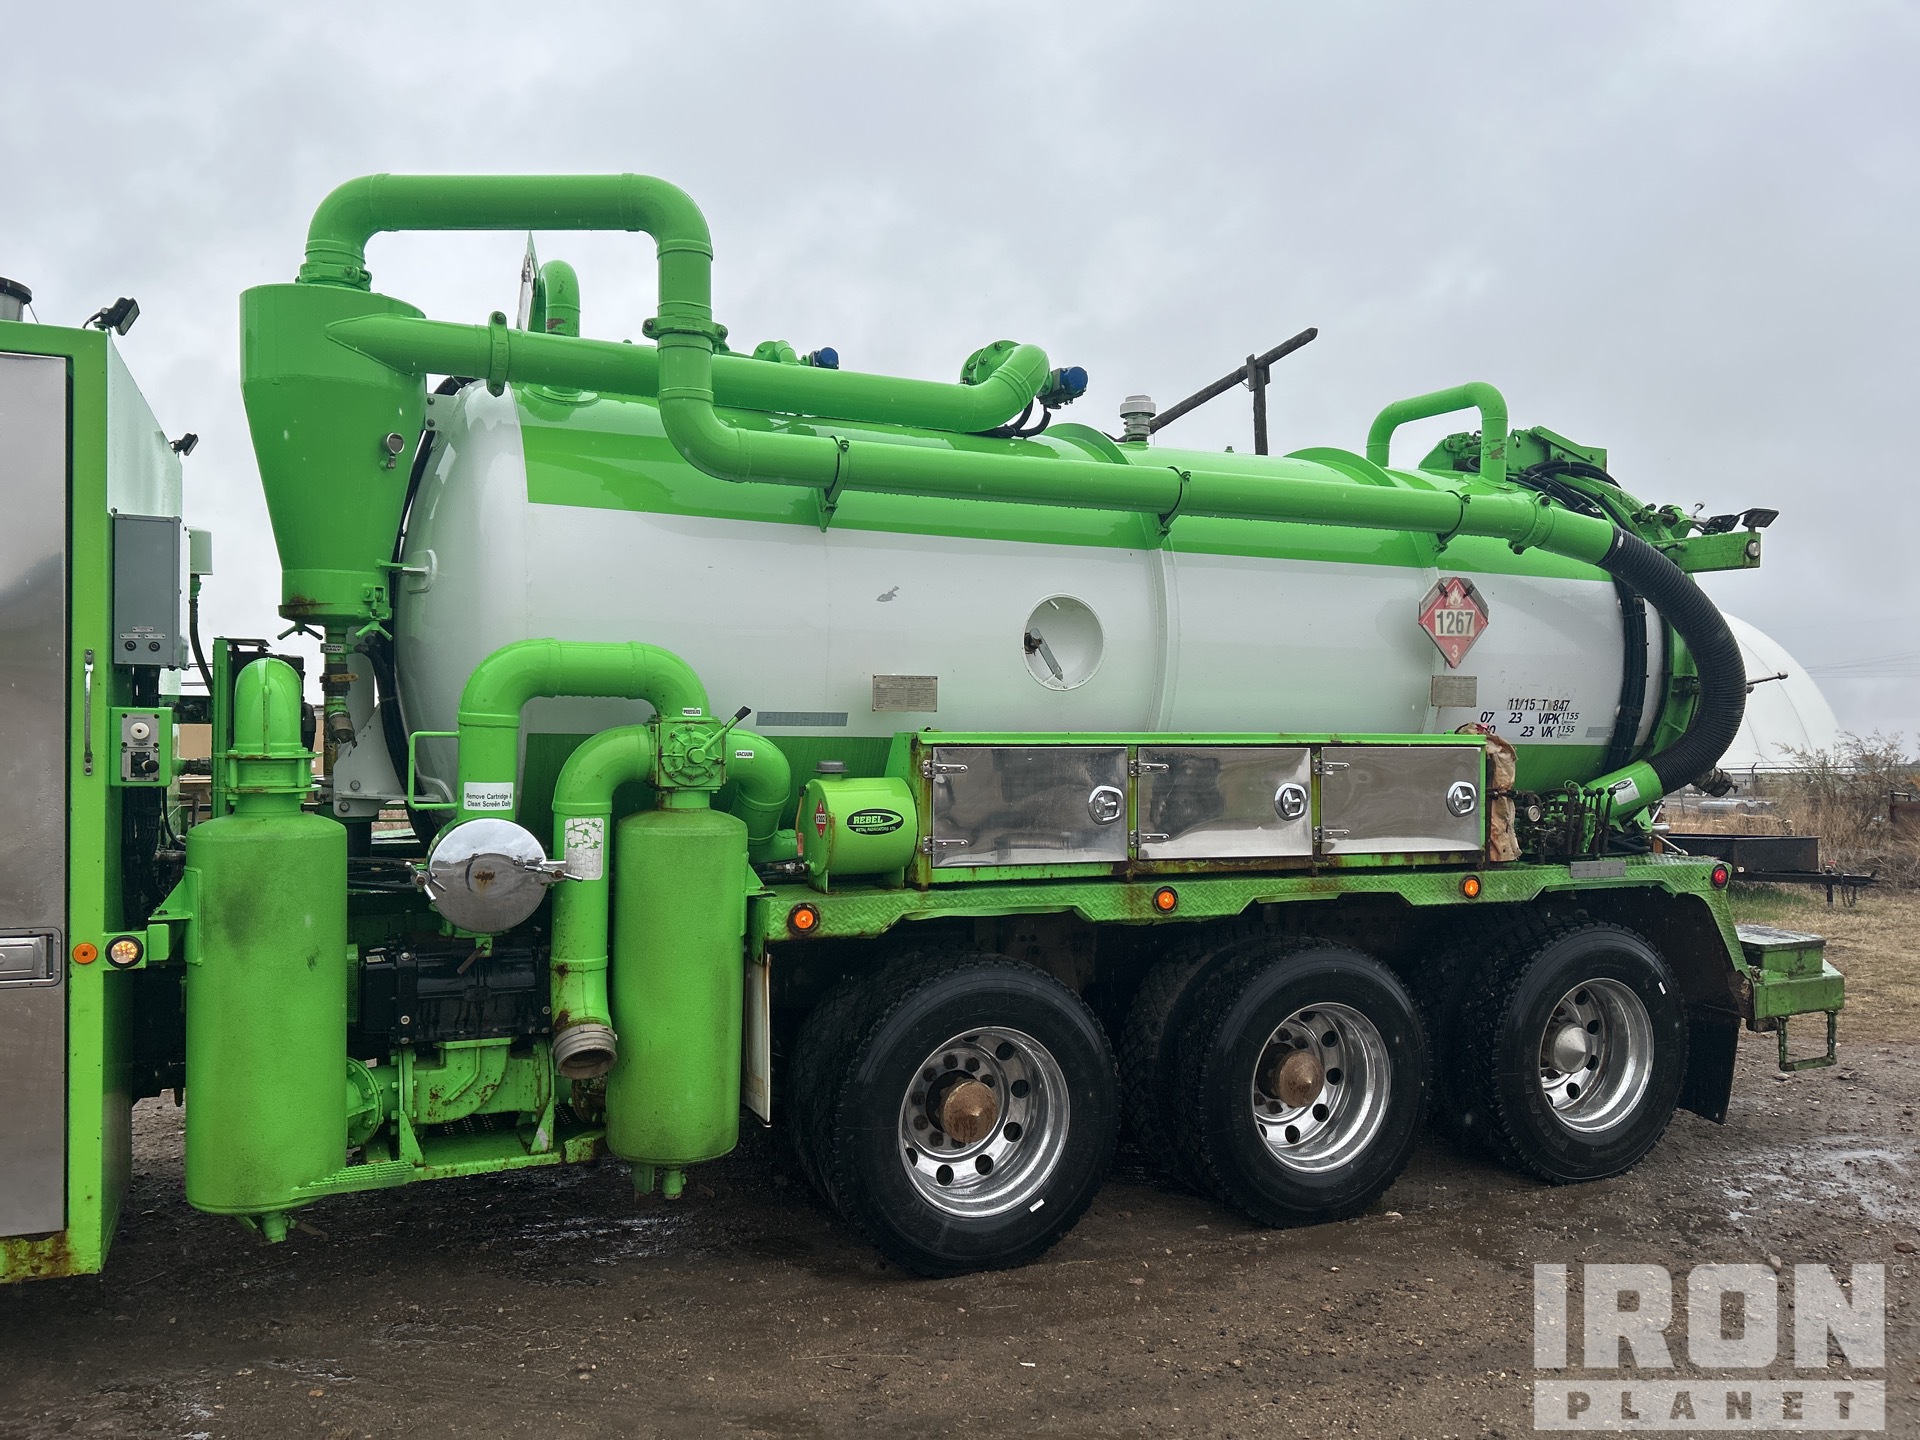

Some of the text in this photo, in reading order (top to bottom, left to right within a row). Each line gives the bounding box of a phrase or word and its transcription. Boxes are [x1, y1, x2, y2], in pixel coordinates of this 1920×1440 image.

[1437, 610, 1474, 635] 1267
[1451, 644, 1459, 658] 3
[1508, 698, 1571, 711] 11/15 T 847
[1480, 711, 1495, 723] 07
[1508, 712, 1523, 724] 23
[1538, 712, 1561, 725] VIPK
[1561, 712, 1579, 720] 1155
[1520, 726, 1535, 738] 23
[1541, 726, 1556, 738] VK
[1557, 725, 1576, 733] 1155
[466, 792, 485, 800] Remove
[486, 793, 508, 801] Cartridge
[482, 800, 500, 808] Screen
[853, 815, 884, 825] REBEL
